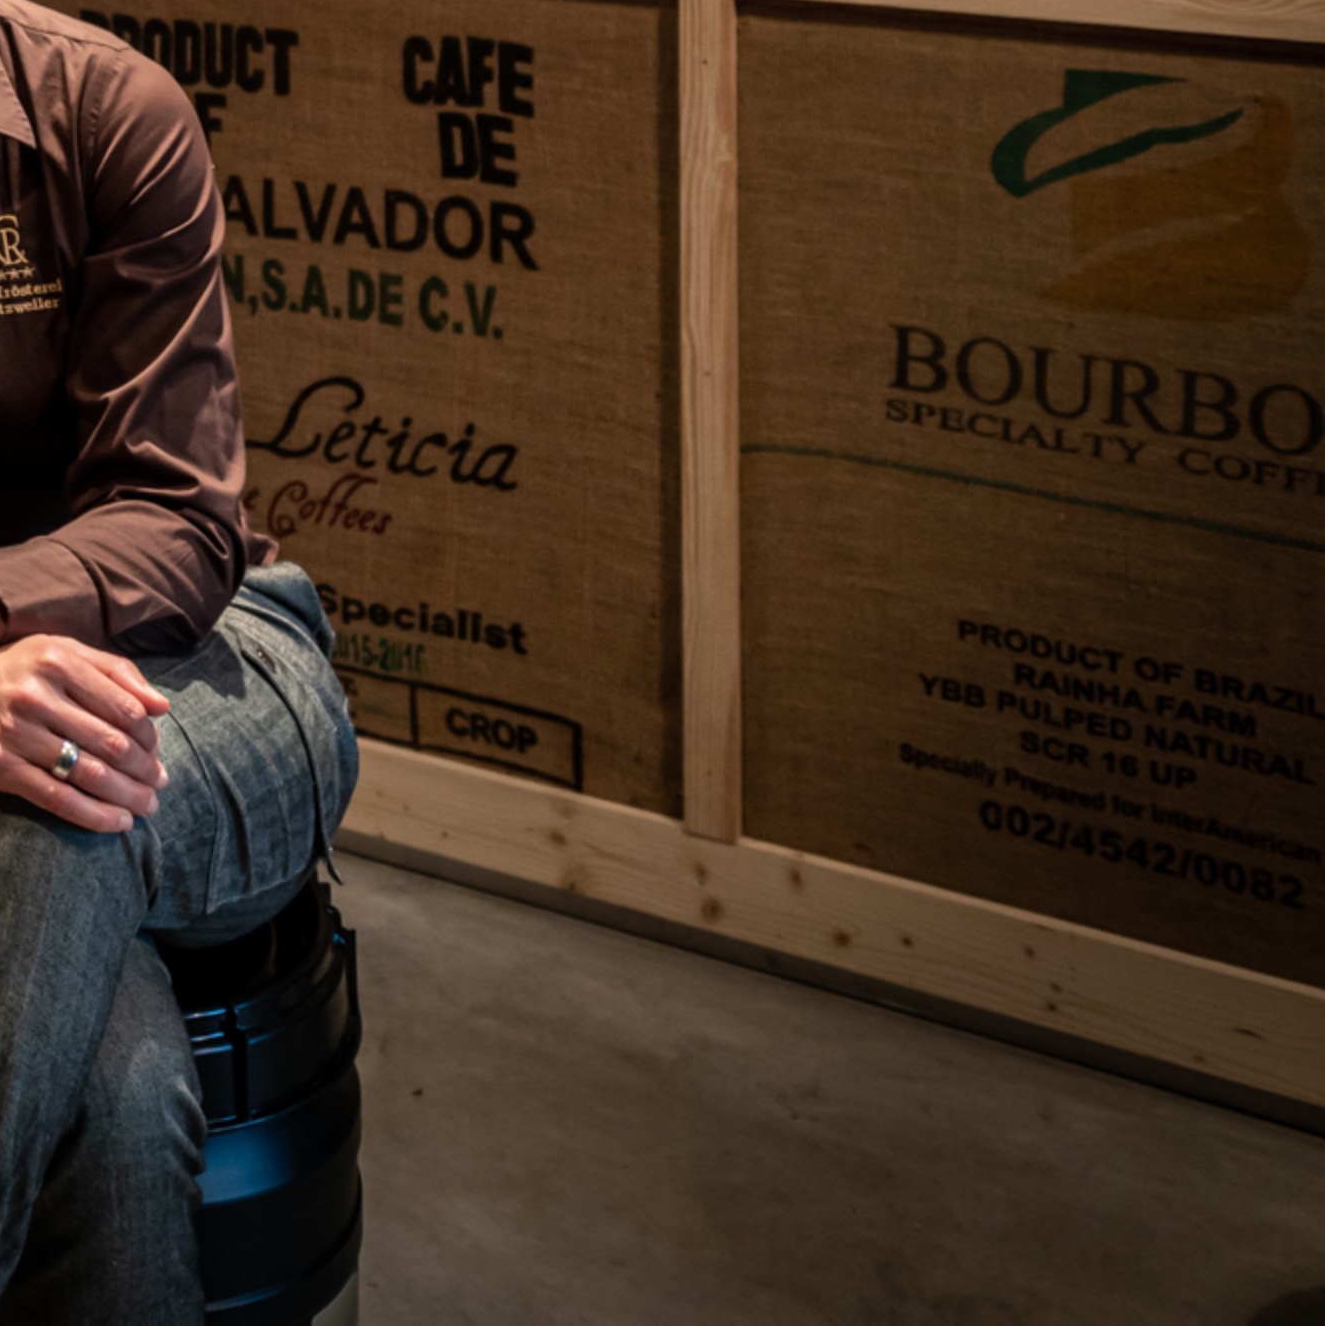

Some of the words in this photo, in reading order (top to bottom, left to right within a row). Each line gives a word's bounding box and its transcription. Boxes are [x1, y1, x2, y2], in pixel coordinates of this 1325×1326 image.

[401, 35, 534, 119] CAFE
[438, 110, 517, 188] DE
[220, 174, 540, 272] ALVADOR
[245, 376, 518, 492] Leticia
[885, 398, 1148, 466] SPECIALTY
[266, 474, 394, 538] Coffees
[315, 582, 529, 656] Specialist
[957, 618, 1123, 674] PRODUCT
[1134, 656, 1184, 686] OF
[1194, 667, 1325, 721] BRAZIL
[1013, 662, 1147, 713] RAINHA
[1154, 694, 1256, 738] FARM
[445, 707, 539, 754] CROP
[919, 673, 987, 708] YBB
[996, 689, 1132, 742] PULPED
[1143, 725, 1317, 786] NATURAL
[1019, 730, 1090, 768] SCR
[1104, 751, 1138, 778] 16
[1150, 760, 1197, 790] UP
[898, 742, 998, 787] Specially
[1004, 766, 1106, 812] Prepared
[1111, 792, 1146, 821] for
[1151, 802, 1321, 865] InterAmerican
[978, 799, 1306, 912] 002/4542/0082
